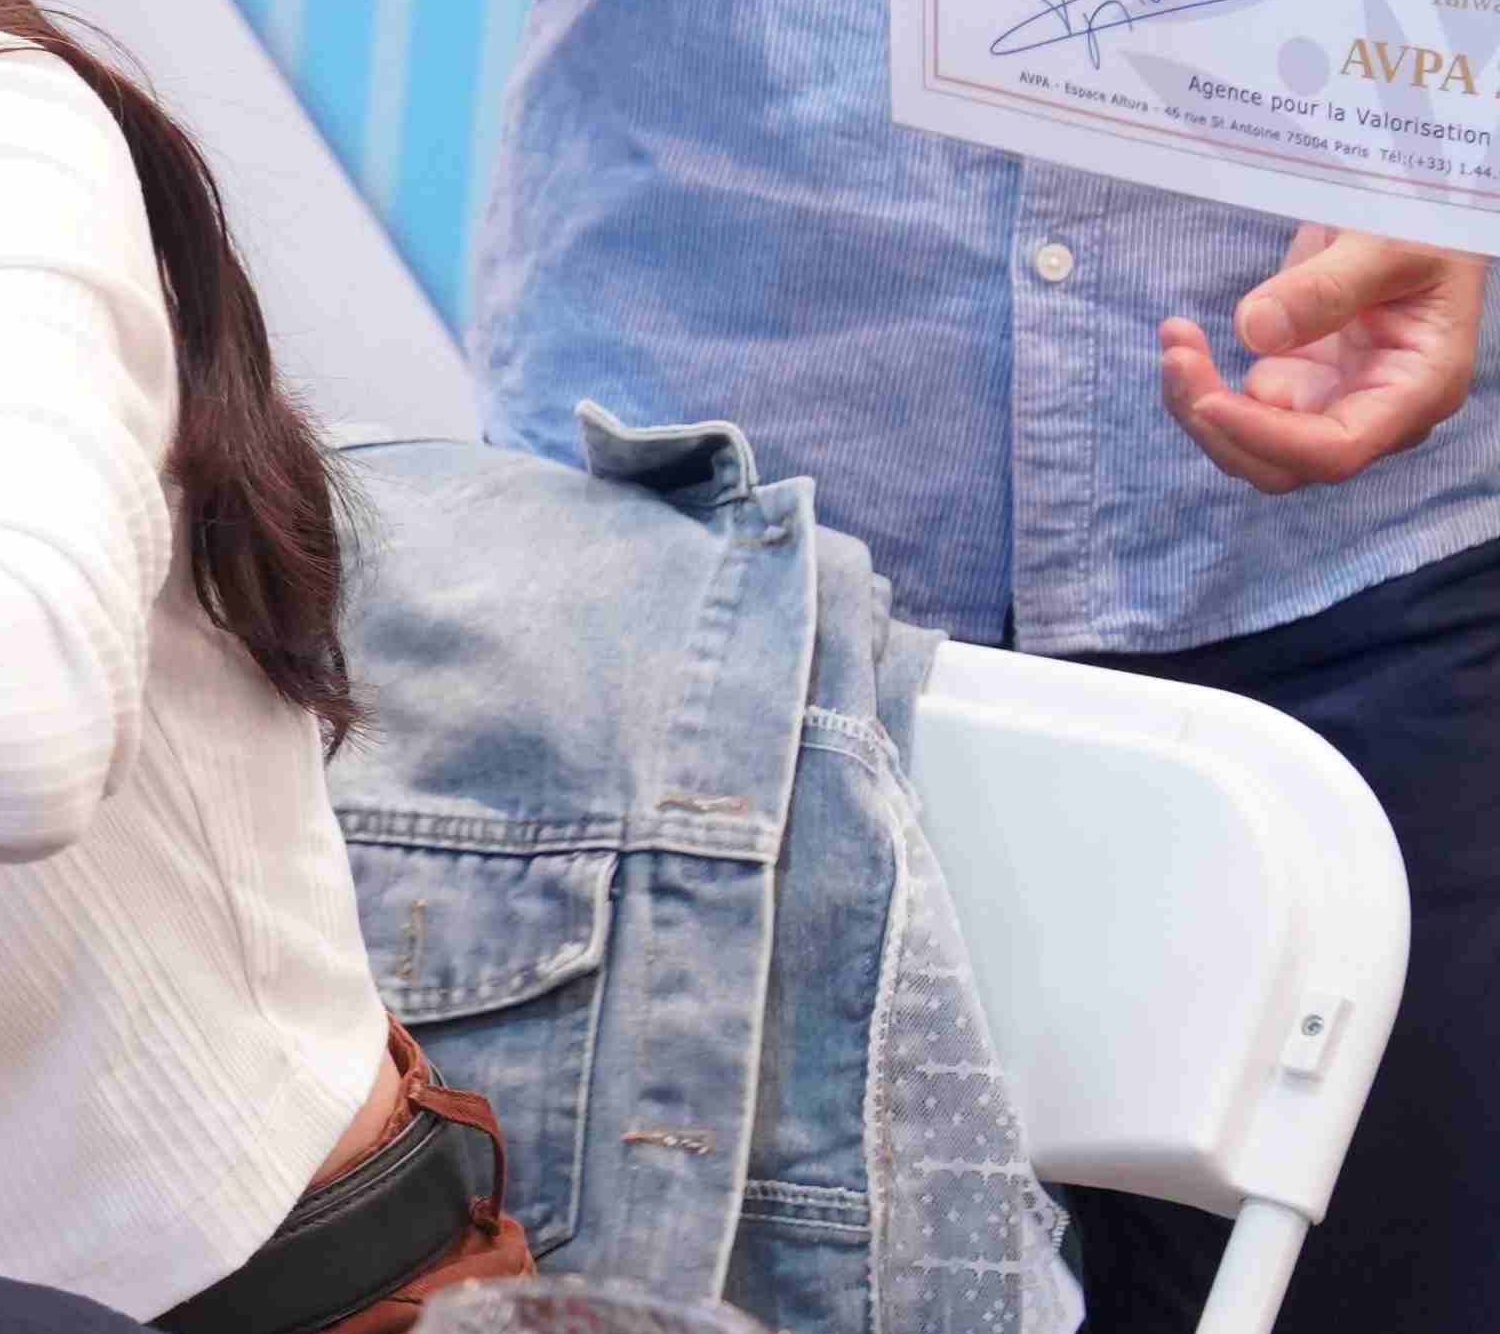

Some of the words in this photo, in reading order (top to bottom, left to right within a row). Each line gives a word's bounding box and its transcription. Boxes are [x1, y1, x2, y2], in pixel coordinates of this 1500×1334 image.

[1340, 37, 1479, 96] AVPA
[1019, 70, 1051, 89] AVPA
[1286, 130, 1329, 151] 75004
[1334, 140, 1370, 160] Paris
[1187, 74, 1263, 107] Agence
[1270, 93, 1320, 117] pour
[1327, 102, 1346, 122] la
[1356, 107, 1492, 147] Valorisation
